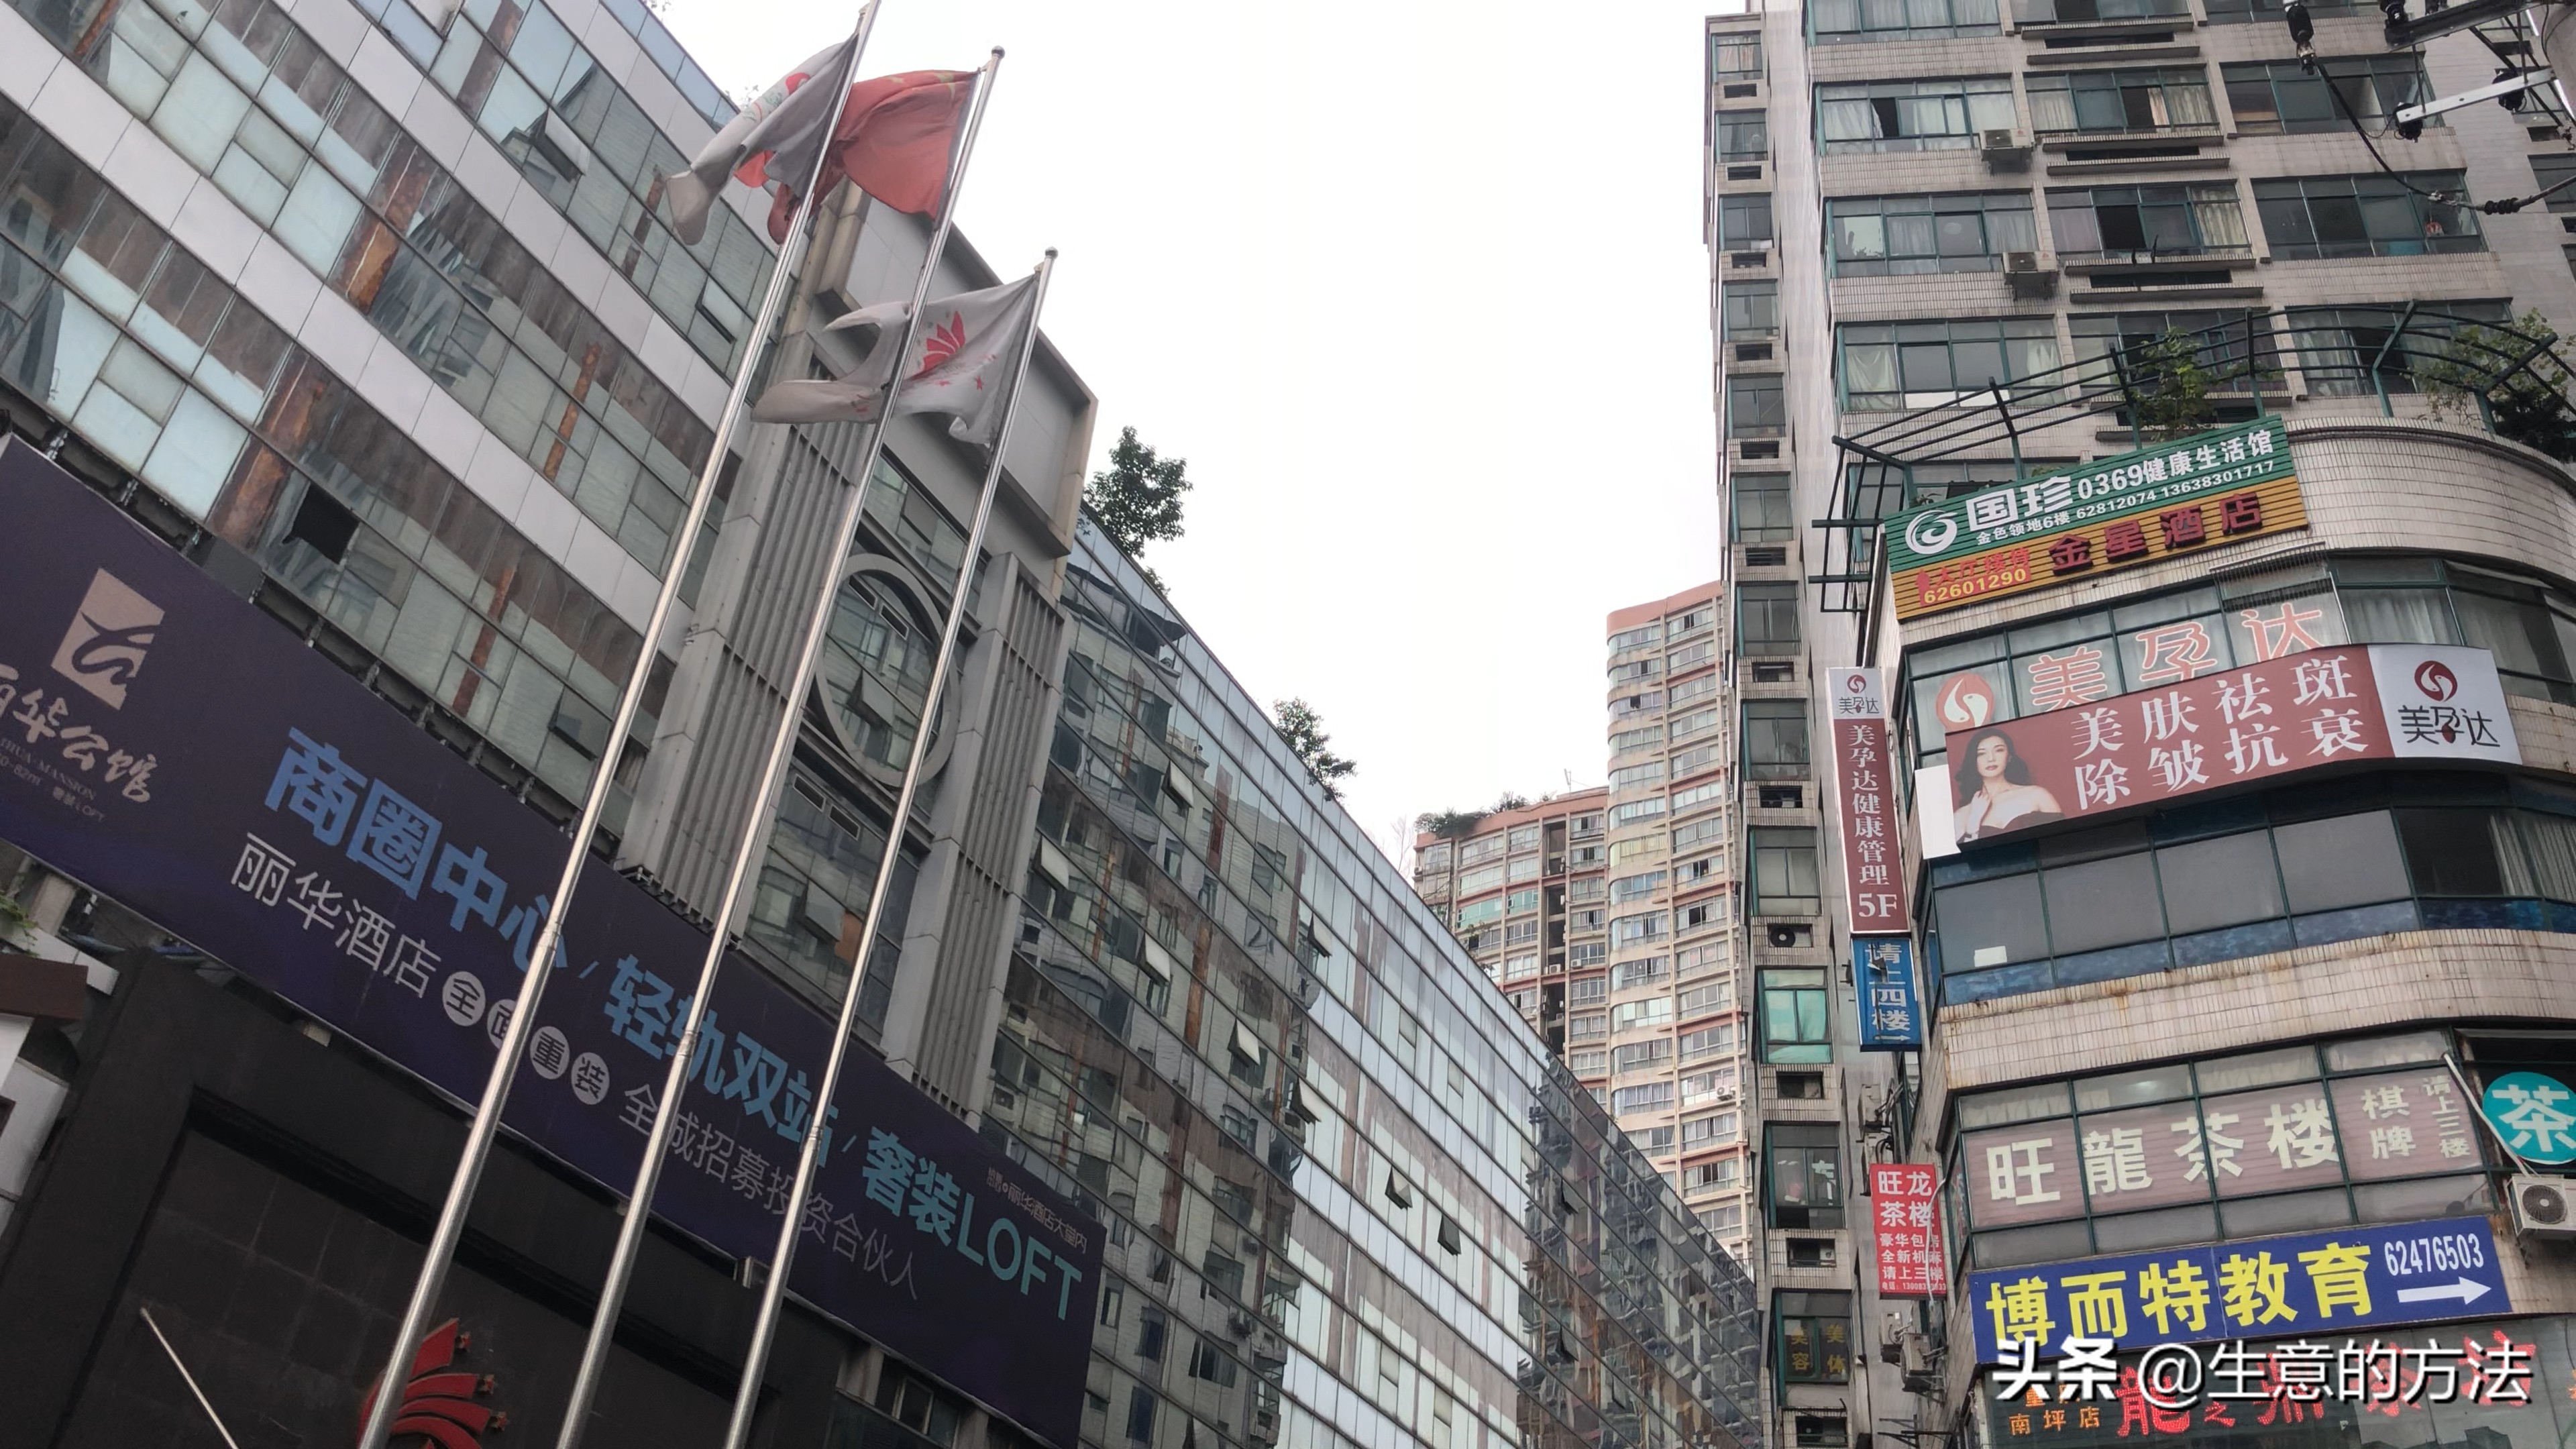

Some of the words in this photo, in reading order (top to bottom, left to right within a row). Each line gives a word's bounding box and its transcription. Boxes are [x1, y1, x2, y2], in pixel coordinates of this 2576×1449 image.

[1966, 475, 2074, 532] 国珍
[2078, 430, 2274, 500] 0369健康生活馆
[1976, 511, 2071, 546] 金色领地6楼
[2076, 490, 2157, 520] 62812074
[2161, 460, 2275, 498] 13638301717
[2049, 492, 2263, 576] 金星酒店
[1923, 568, 2027, 604] 62601290
[2071, 655, 2357, 761] 美肤祛斑
[2074, 709, 2369, 811] 除皱抗衰
[1848, 724, 1891, 886] 美孕达健康管理
[230, 832, 441, 999] 丽华酒店
[1858, 894, 1898, 918] 5F
[265, 727, 568, 974] 商圈中心
[862, 1126, 1082, 1321] 奢装LOFT
[1865, 943, 1911, 1031] 请上四楼
[1986, 1099, 2339, 1207] 旺龍茶楼
[2361, 1085, 2416, 1159] 棋牌
[2422, 1075, 2471, 1159] 请上三楼
[2492, 1084, 2576, 1152] 茶
[1878, 1171, 1932, 1196] 旺龙
[1880, 1201, 1935, 1228] 茶楼
[1882, 1266, 1943, 1280] 请上三楼
[1984, 1242, 2371, 1344] 博而特教育
[2384, 1232, 2485, 1278] 62476503
[2009, 1406, 2100, 1436] 南坪店
